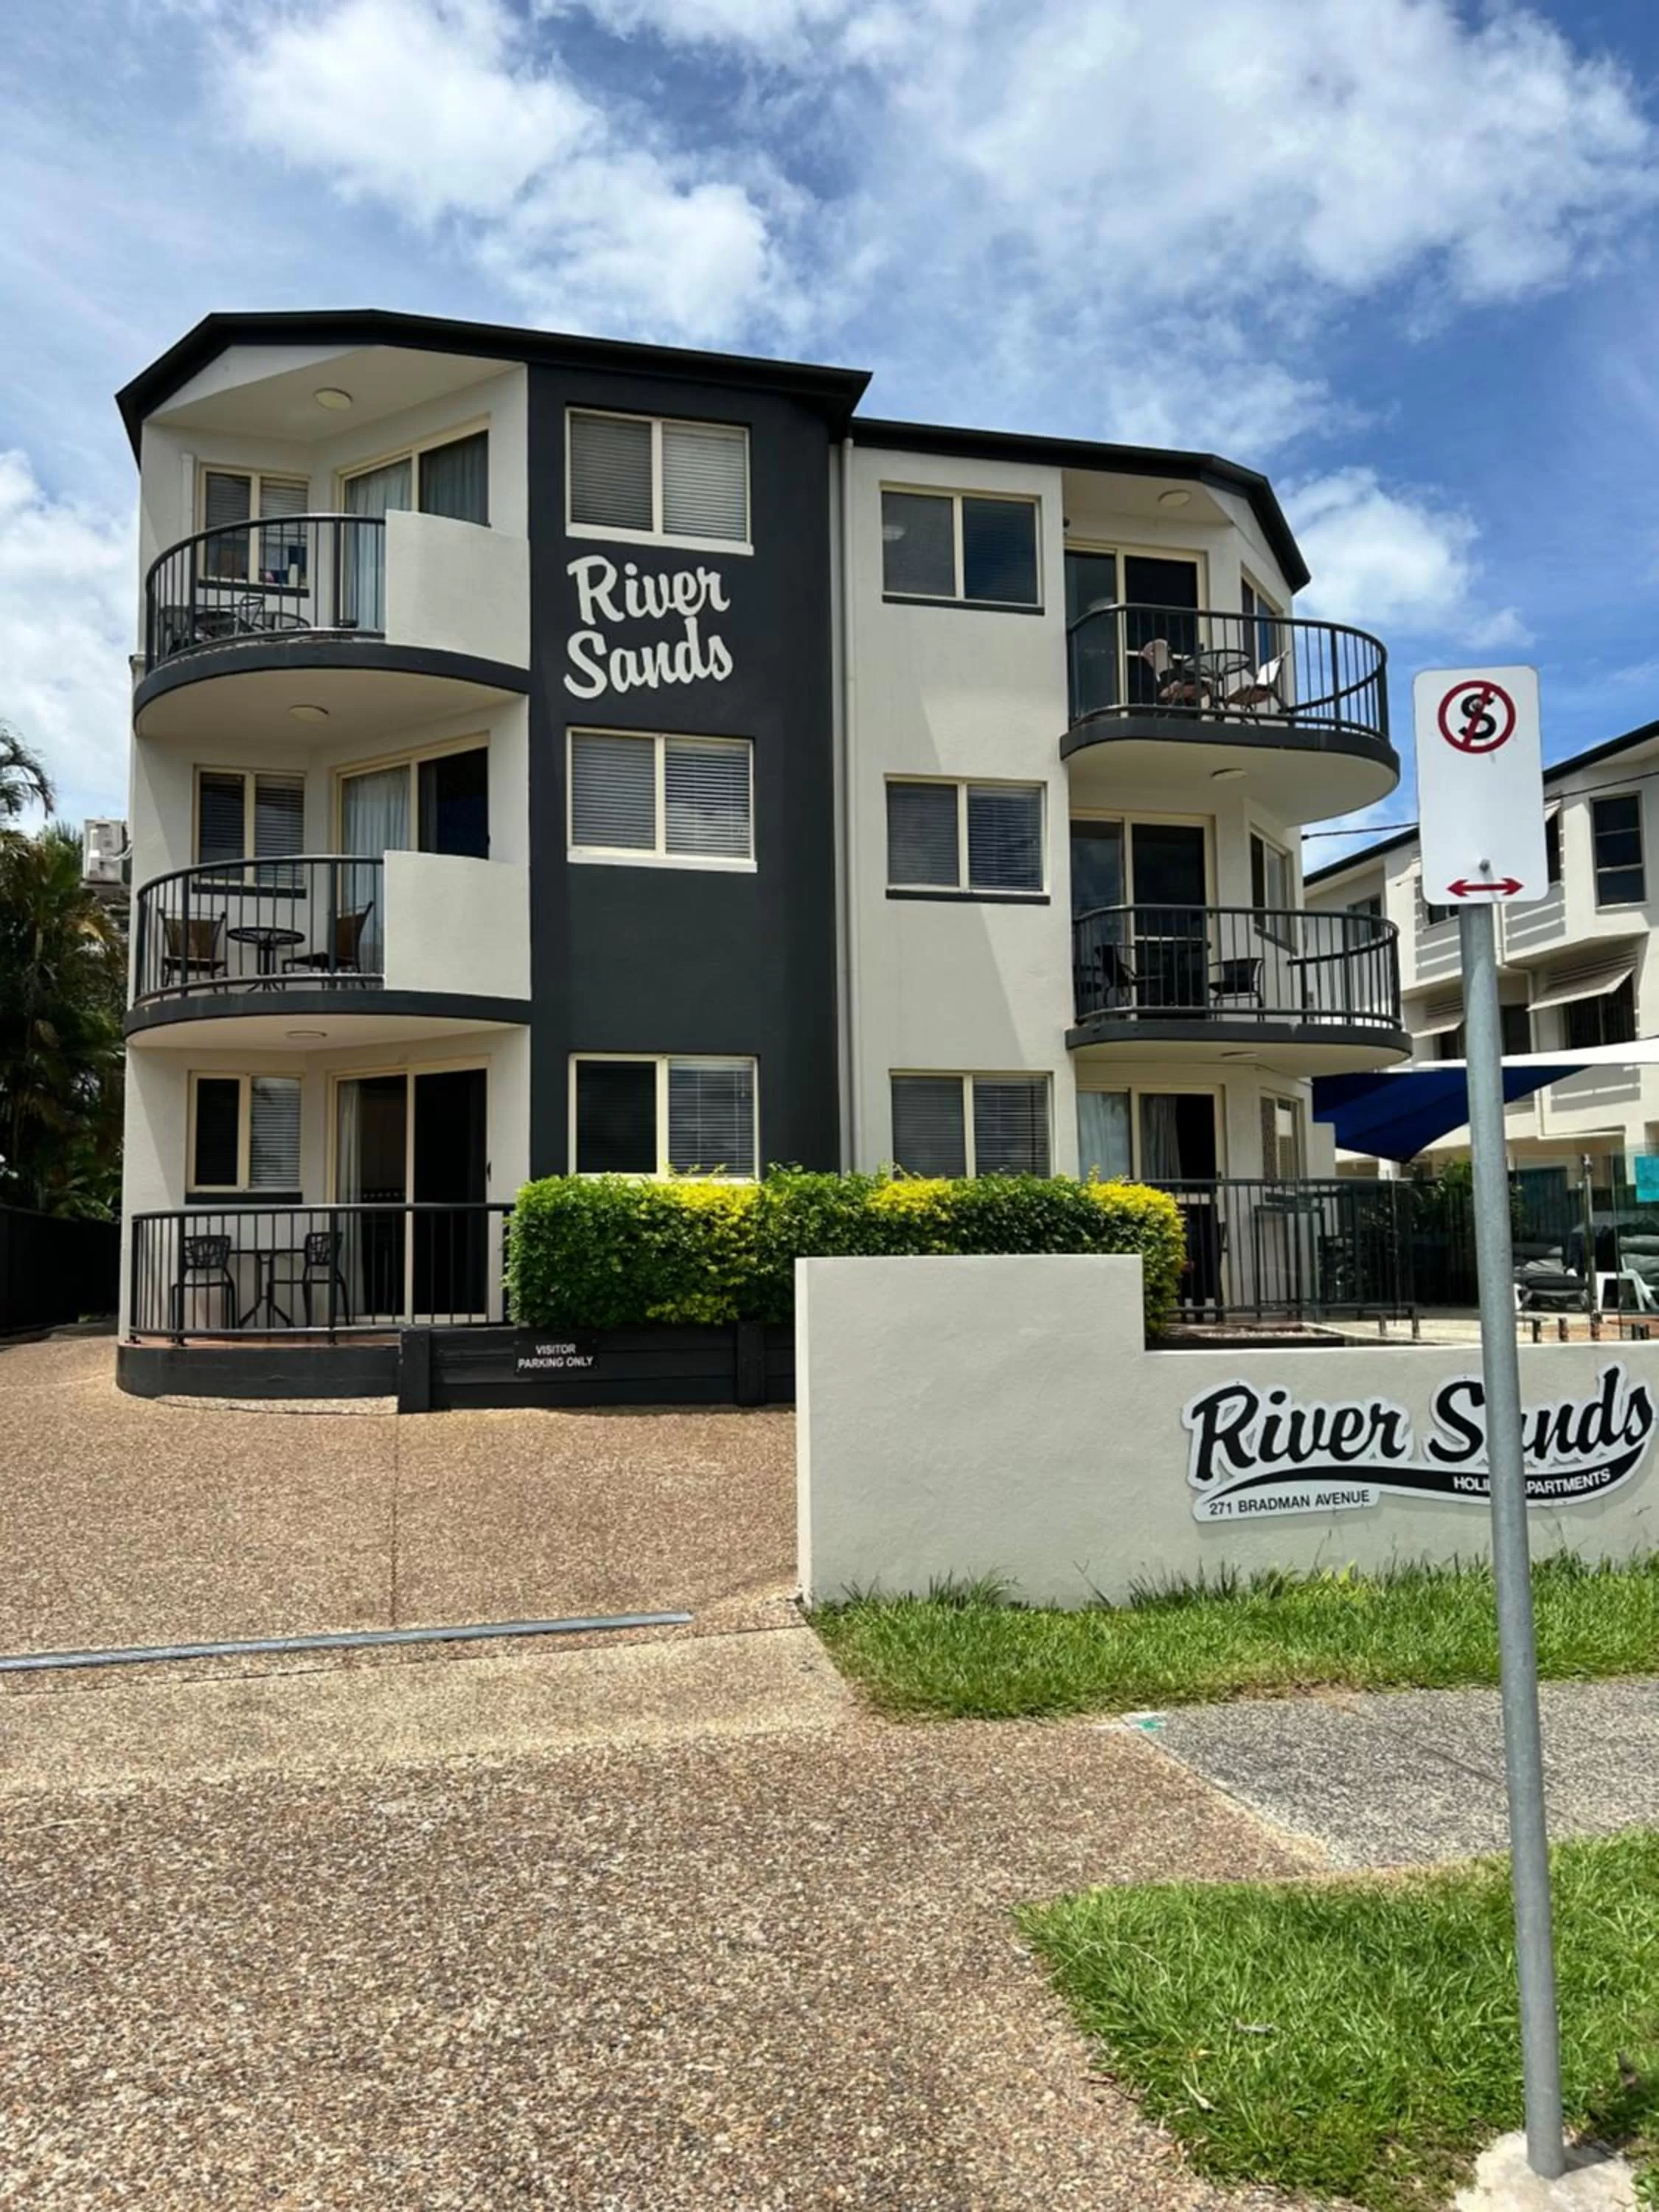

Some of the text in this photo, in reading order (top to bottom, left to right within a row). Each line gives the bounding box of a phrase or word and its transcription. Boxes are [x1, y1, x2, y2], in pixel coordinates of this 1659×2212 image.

[566, 555, 731, 625] River
[563, 616, 734, 699] Sands
[535, 1343, 576, 1354] VISITOR
[518, 1356, 594, 1368] PARKING ONLY
[1192, 1367, 1653, 1481] River Snds
[1453, 1469, 1610, 1495] HOLI PARTMENTS
[1209, 1489, 1369, 1515] 271 BRADMAN AVENUE
